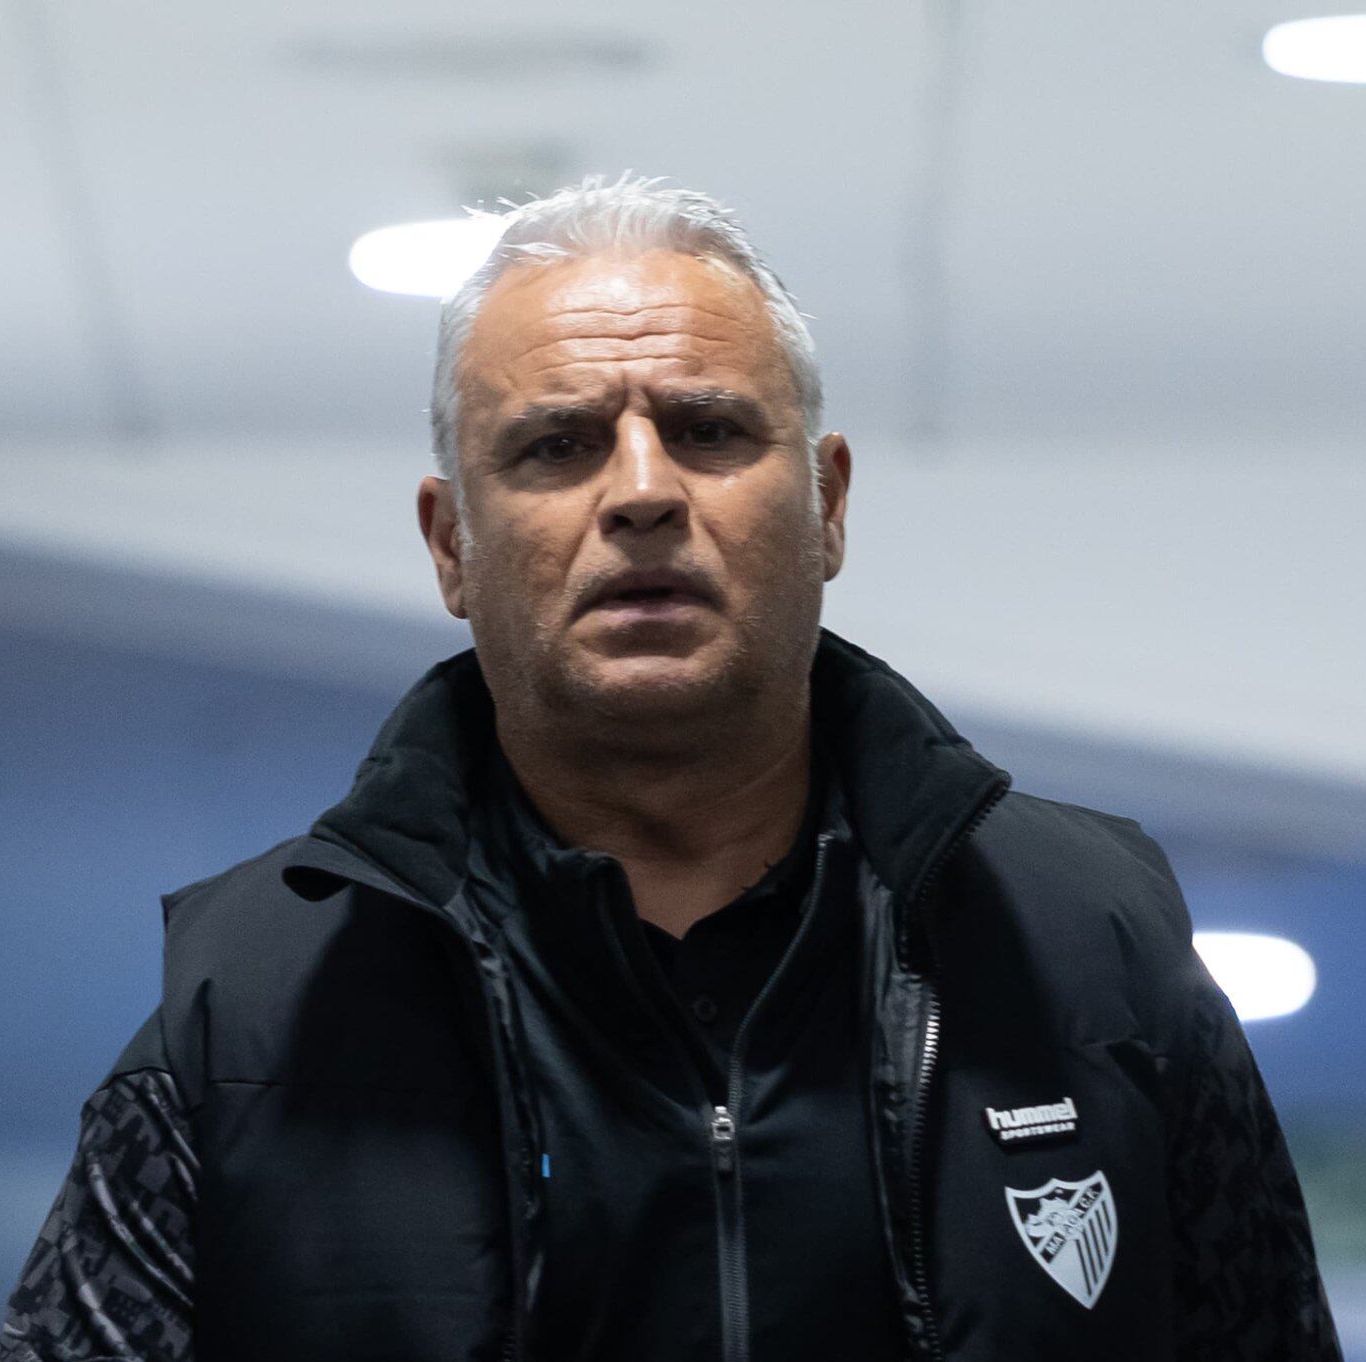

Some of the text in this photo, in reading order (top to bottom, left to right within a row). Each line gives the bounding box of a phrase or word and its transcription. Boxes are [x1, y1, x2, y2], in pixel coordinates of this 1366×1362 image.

[985, 1097, 1078, 1130] hummel
[1000, 1122, 1075, 1140] SPORTSWEAR
[1045, 1207, 1086, 1256] MAAGA
